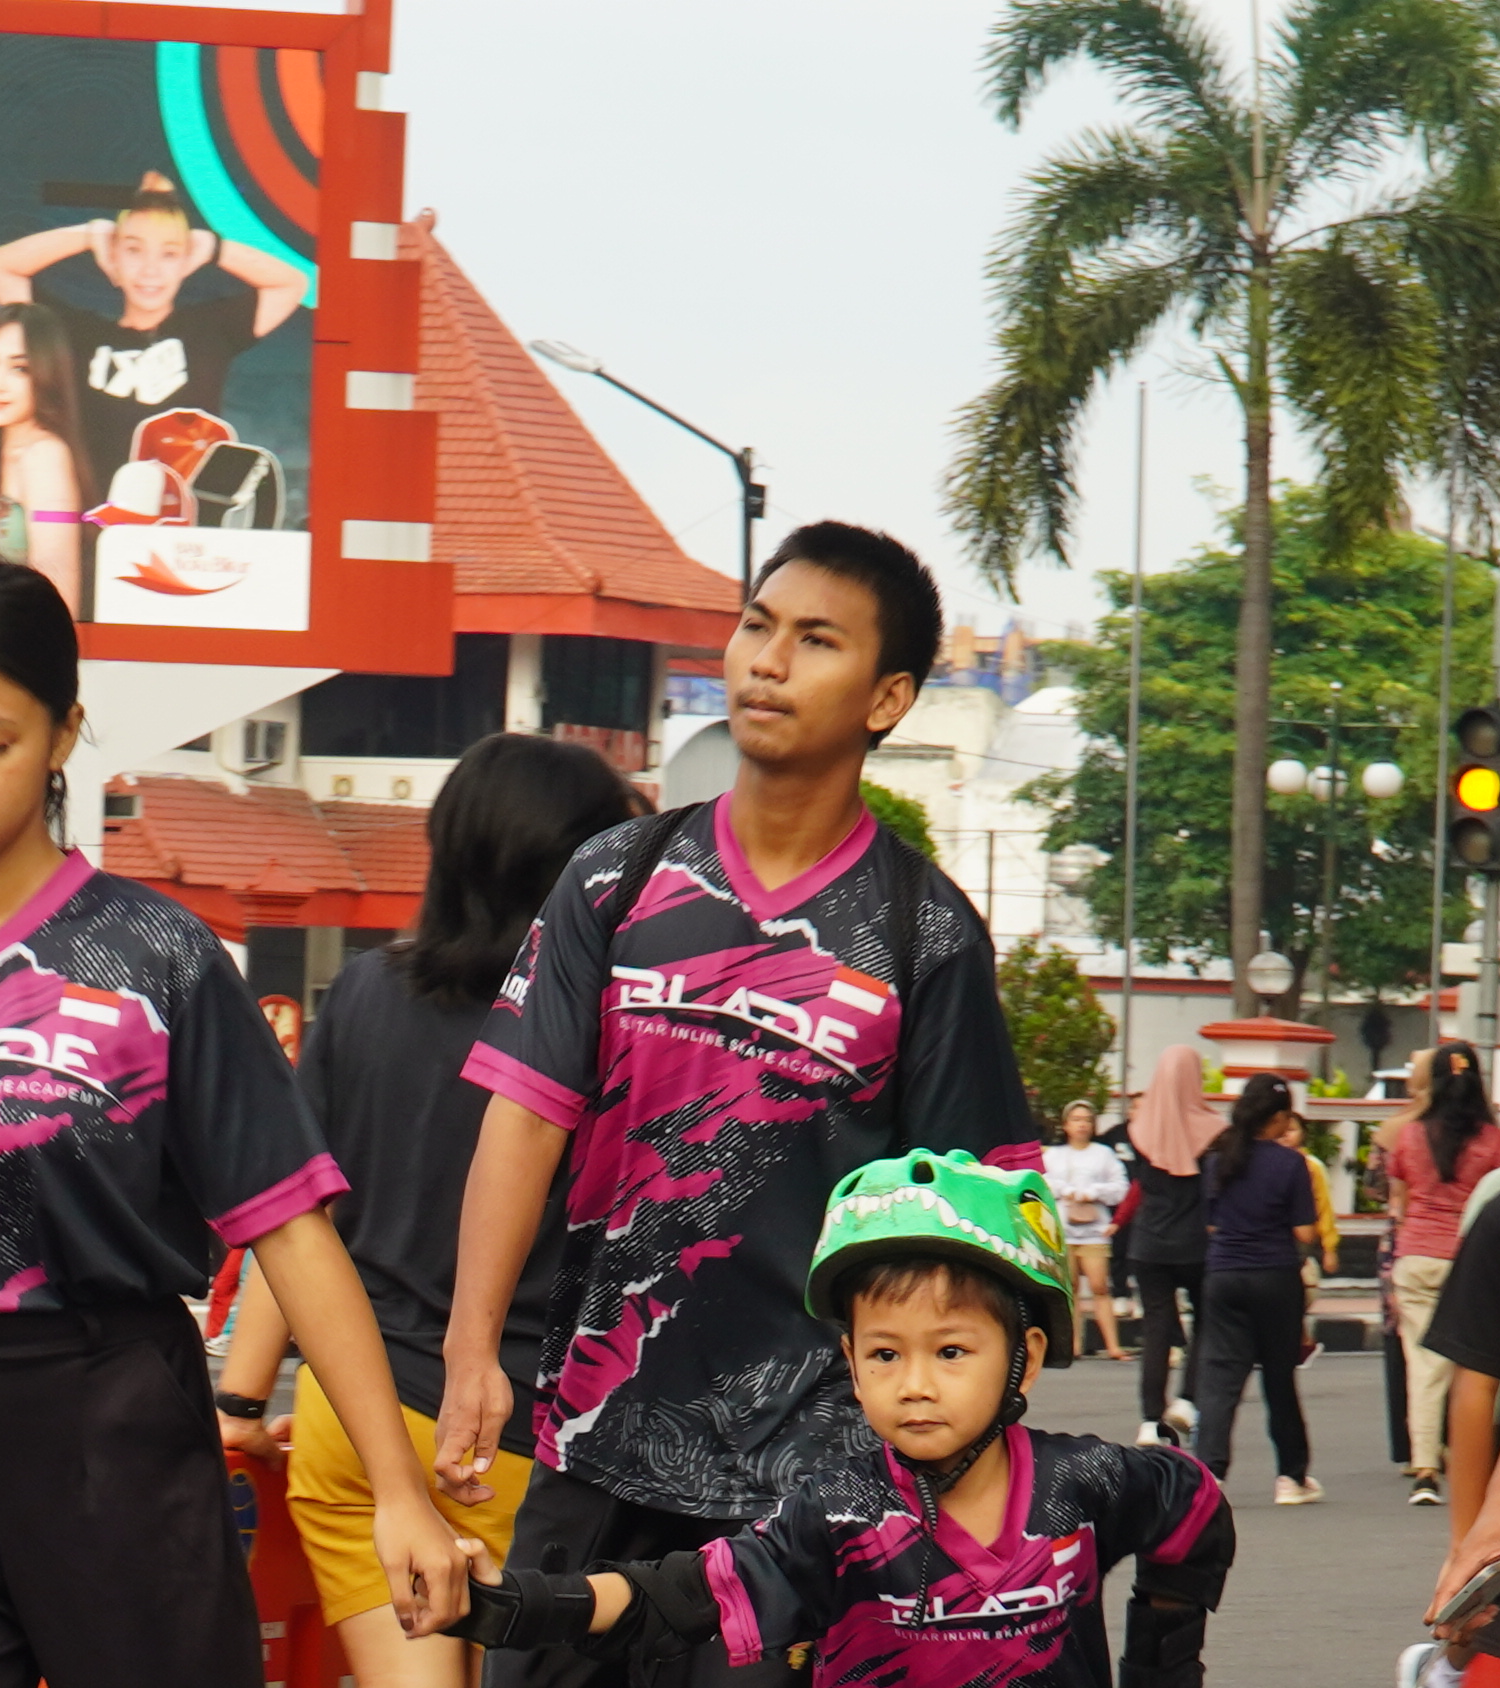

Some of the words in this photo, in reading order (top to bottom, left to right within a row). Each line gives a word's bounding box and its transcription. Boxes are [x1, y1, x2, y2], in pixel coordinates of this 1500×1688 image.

[611, 964, 860, 1056] BLADE
[670, 1023, 726, 1051] INLINE
[728, 1038, 776, 1067] SKATE
[776, 1056, 853, 1091] ACADEMY
[15, 1080, 106, 1110] ACADEMY
[877, 1570, 1077, 1626] BLADE
[893, 1627, 939, 1642] BLITAR
[942, 1629, 990, 1642] INLINE
[995, 1623, 1039, 1640] SKATE
